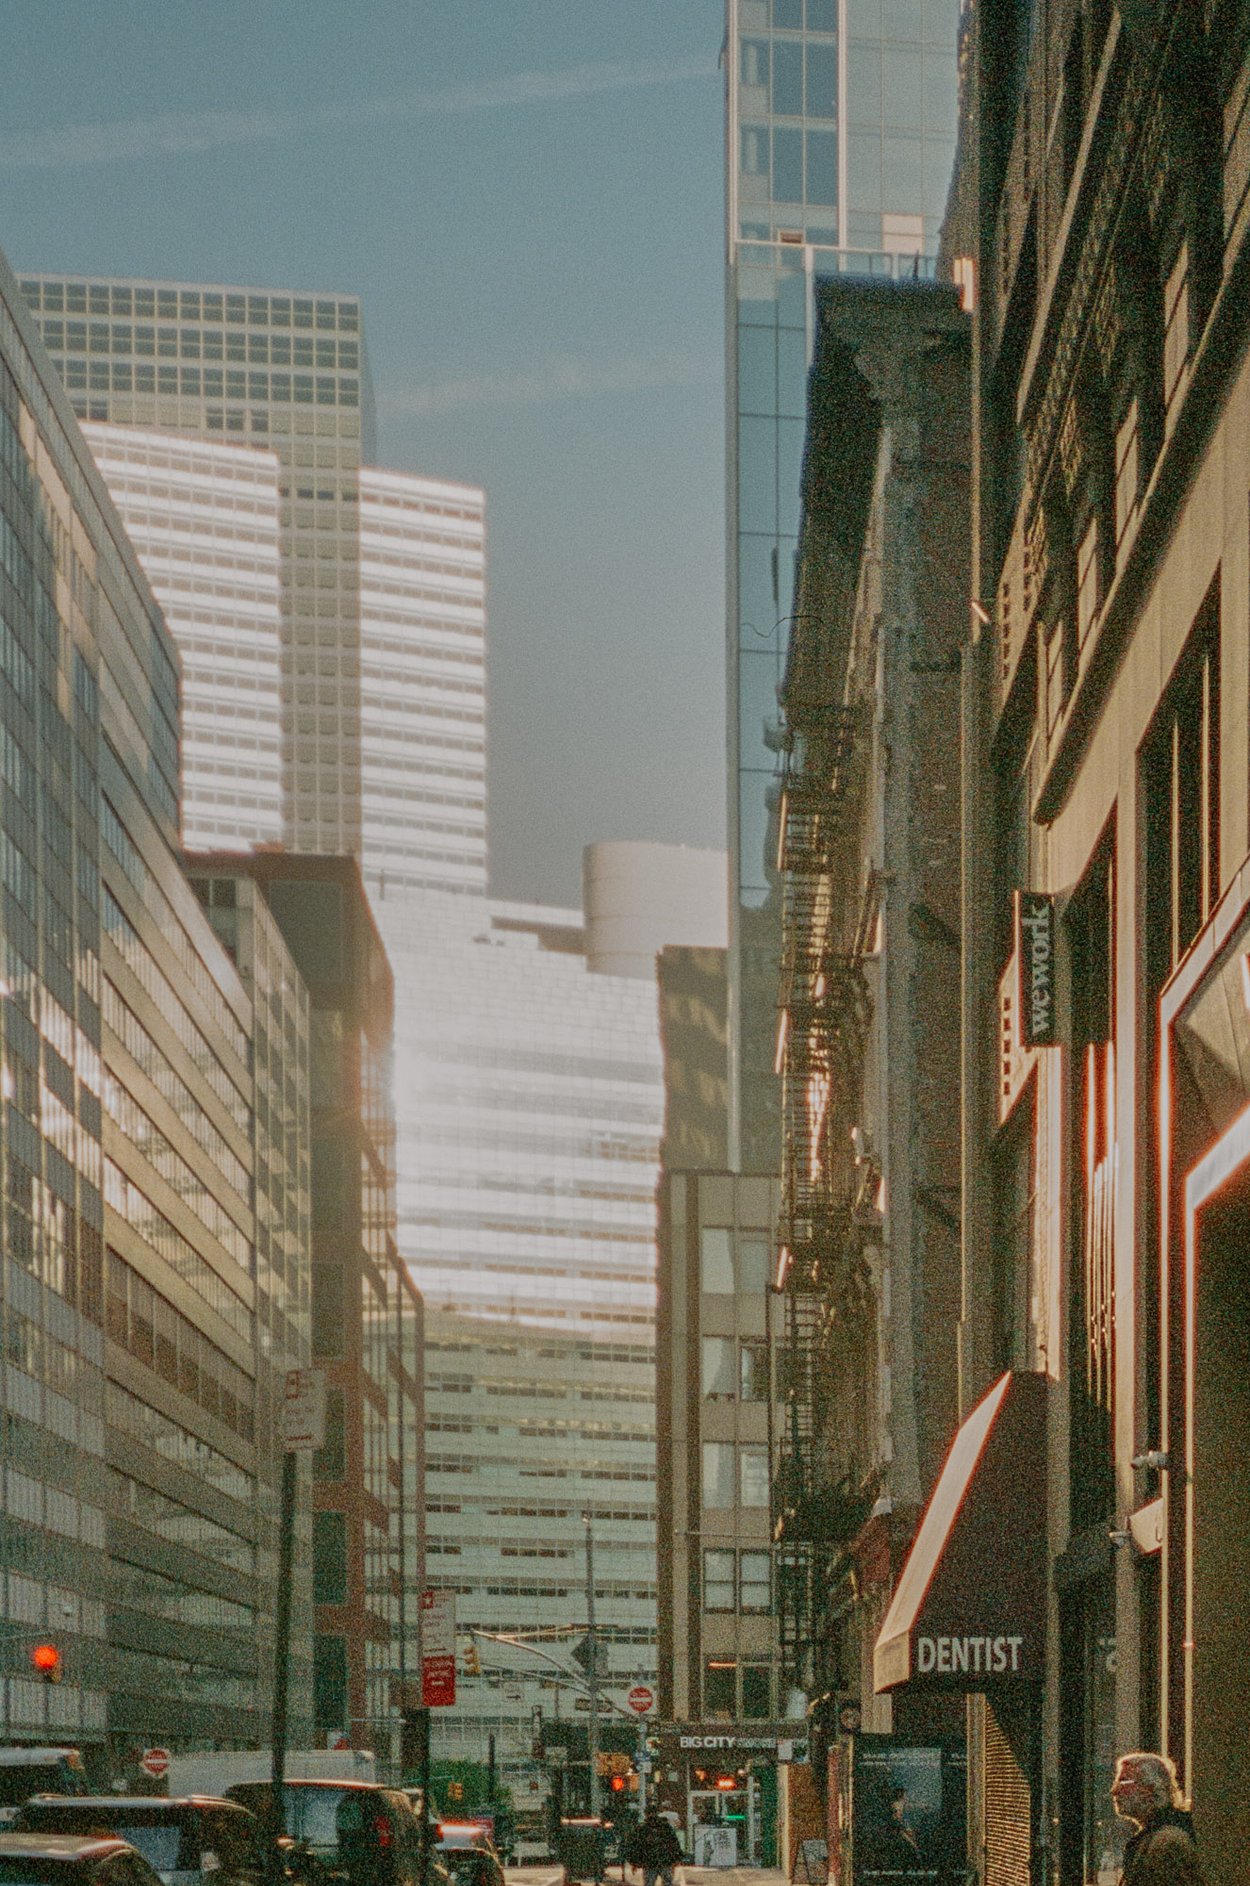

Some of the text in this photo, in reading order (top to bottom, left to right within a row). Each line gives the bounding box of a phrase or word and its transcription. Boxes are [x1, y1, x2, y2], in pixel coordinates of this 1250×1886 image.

[1022, 902, 1051, 1035] wework
[918, 1636, 1023, 1672] DENTIST
[680, 1736, 702, 1748] BIG
[703, 1736, 737, 1748] CITY
